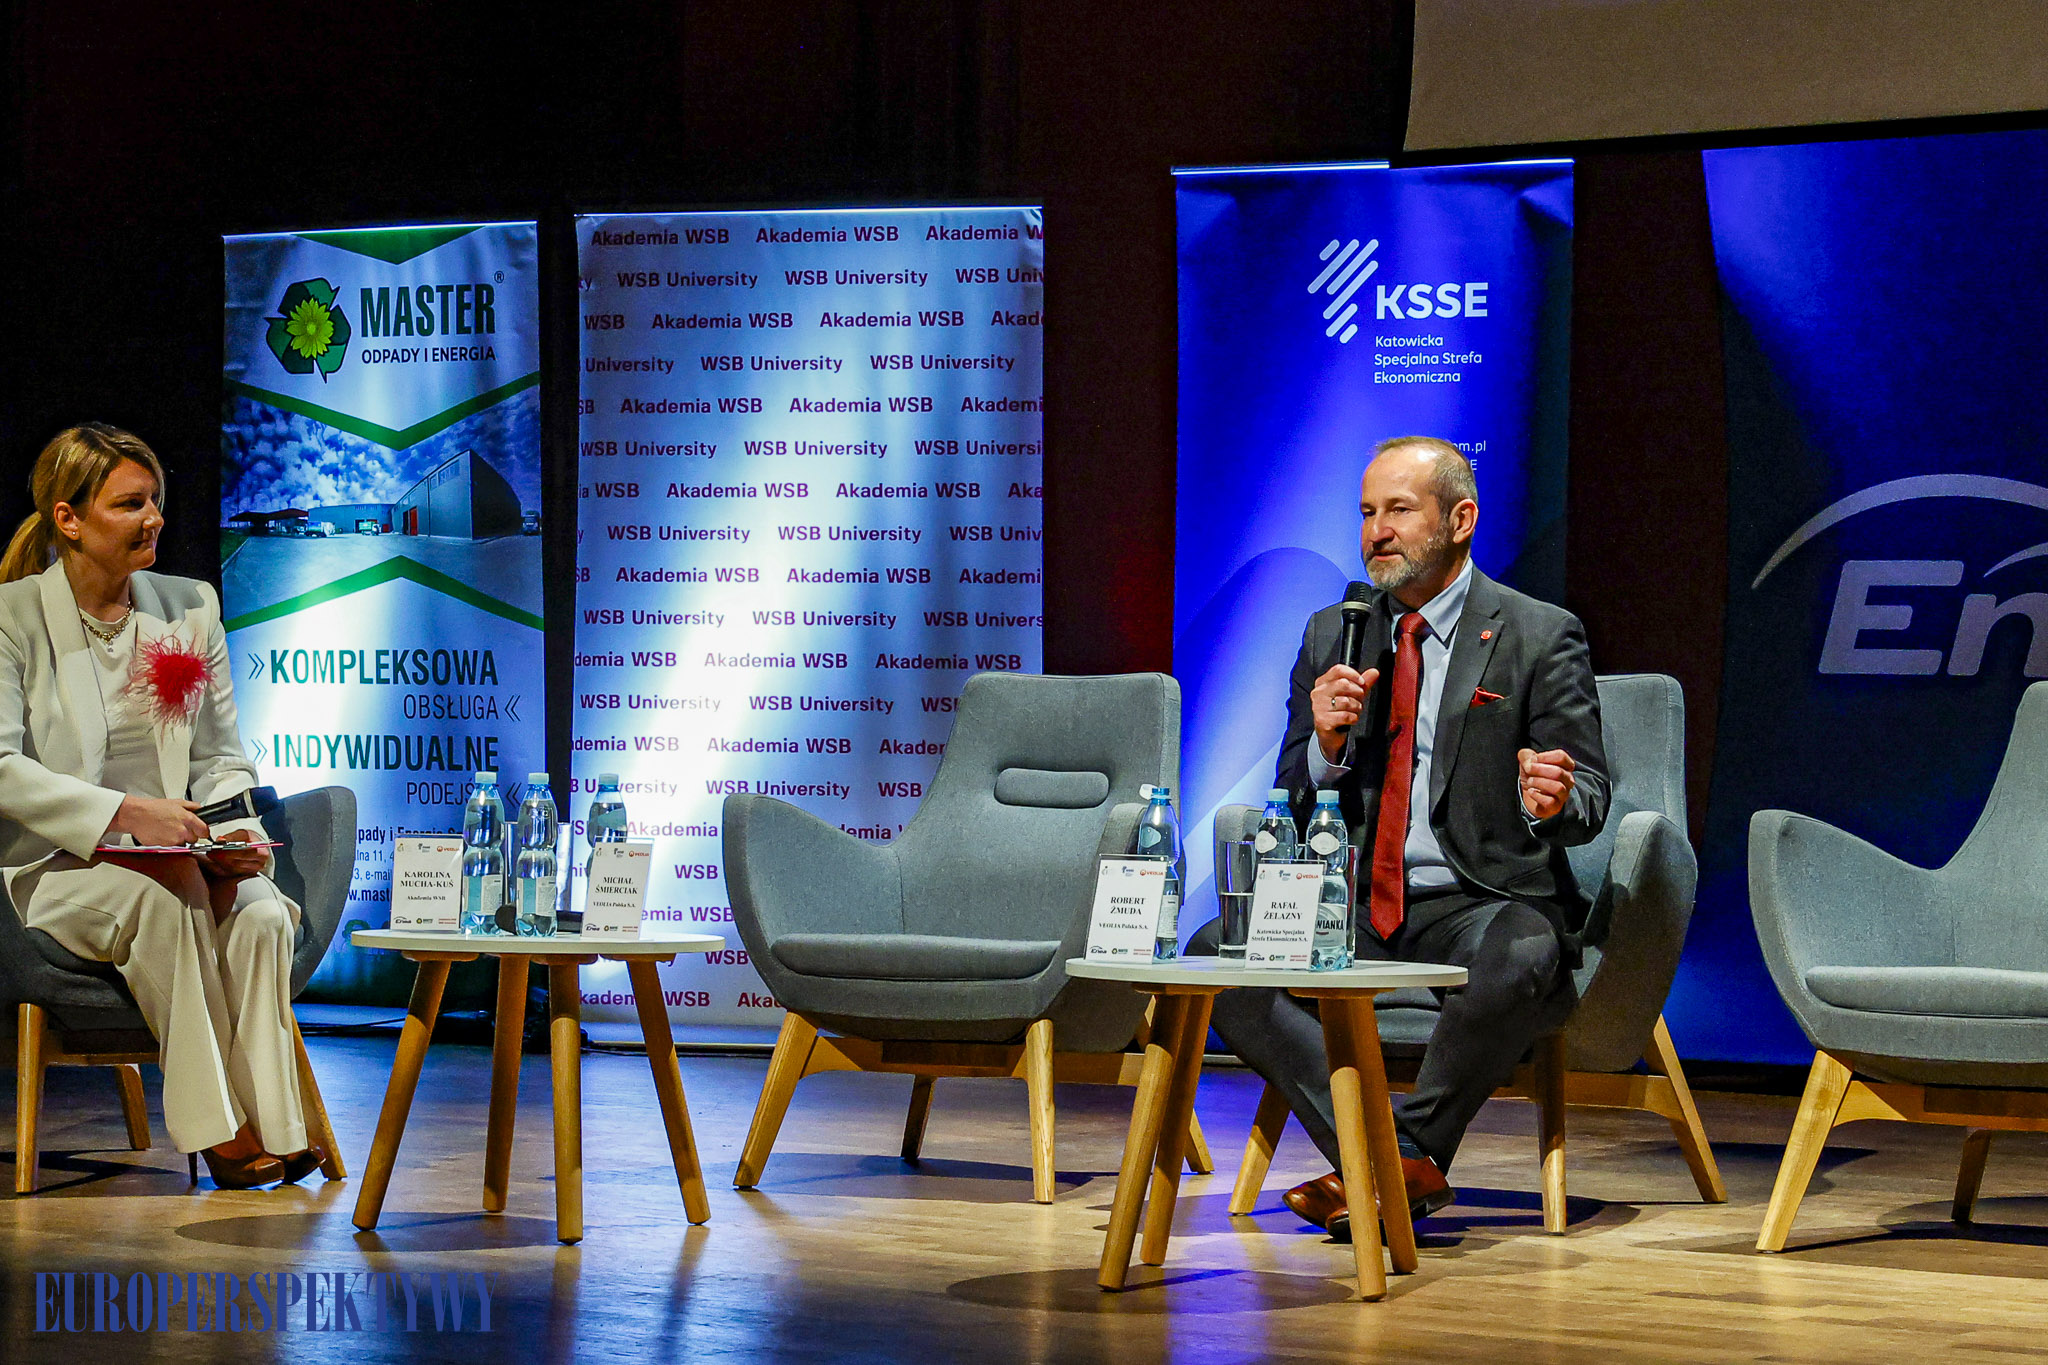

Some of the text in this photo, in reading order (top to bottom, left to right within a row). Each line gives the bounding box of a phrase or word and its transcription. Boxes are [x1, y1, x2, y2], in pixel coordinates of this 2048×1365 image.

[591, 229, 729, 246] Akademia WSB
[755, 227, 899, 243] Akademia WSB
[926, 225, 1019, 241] Akademia
[617, 272, 758, 289] WSB University
[785, 270, 928, 287] WSB University
[955, 268, 999, 284] WSB
[1376, 282, 1489, 320] KSSE
[360, 283, 496, 338] MASTER
[584, 315, 624, 329] WSB
[651, 313, 794, 329] Akademia WSB
[819, 311, 964, 328] Akademia WSB
[1375, 334, 1444, 348] Katowicka
[361, 346, 496, 364] ODPADY I ENERGIA
[869, 354, 1015, 372] WSB University
[1374, 351, 1482, 368] Specjalna Strefa
[585, 357, 674, 374] University
[700, 356, 843, 373] WSB University
[1374, 371, 1461, 384] Ekonomiczna
[620, 398, 763, 414] Akademia WSB
[789, 397, 934, 413] Akademia WSB
[581, 441, 717, 458] WSB University
[744, 441, 888, 458] WSB University
[914, 440, 959, 455] WSB
[595, 483, 640, 498] WSB
[666, 483, 809, 498] Akademia WSB
[836, 482, 981, 498] Akademia WSB
[607, 526, 750, 543] WSB University
[778, 525, 922, 543] WSB University
[949, 526, 994, 541] WSB
[616, 568, 760, 583] Akademia WSB
[787, 568, 931, 584] Akademia WSB
[583, 610, 724, 628] WSB University
[752, 610, 897, 629] WSB University
[923, 611, 969, 627] WSB
[271, 649, 498, 685] KOMPLEKSOWA
[631, 652, 677, 667] WSB
[704, 652, 848, 669] Akademia WSB
[875, 654, 1022, 670] Akademia WSB
[403, 694, 498, 720] OBSŁUGA
[580, 694, 721, 712] WSB University
[749, 696, 894, 714] WSB University
[634, 736, 680, 751] WSB
[707, 738, 852, 754] Akademia WSB
[273, 734, 499, 772] INDYWIDUALNE
[407, 777, 499, 805] PODEJŚ
[585, 779, 678, 796] Uversity
[706, 780, 851, 799] WSB University
[878, 782, 922, 798] WSB
[626, 821, 718, 837] Akademia
[674, 865, 719, 880] WSB
[400, 879, 454, 888] MUCHA-KUŚ
[603, 877, 634, 885] MICHAŁ
[595, 885, 638, 895] ŚMIERCIAK
[1110, 896, 1146, 905] ROBERT
[1271, 901, 1298, 909] RAFAŁ
[689, 907, 733, 922] WSB
[1110, 905, 1142, 915] ŻMUDA
[1263, 910, 1303, 920] ŻELAZNY
[705, 950, 749, 966] WSB
[665, 992, 711, 1007] WSB
